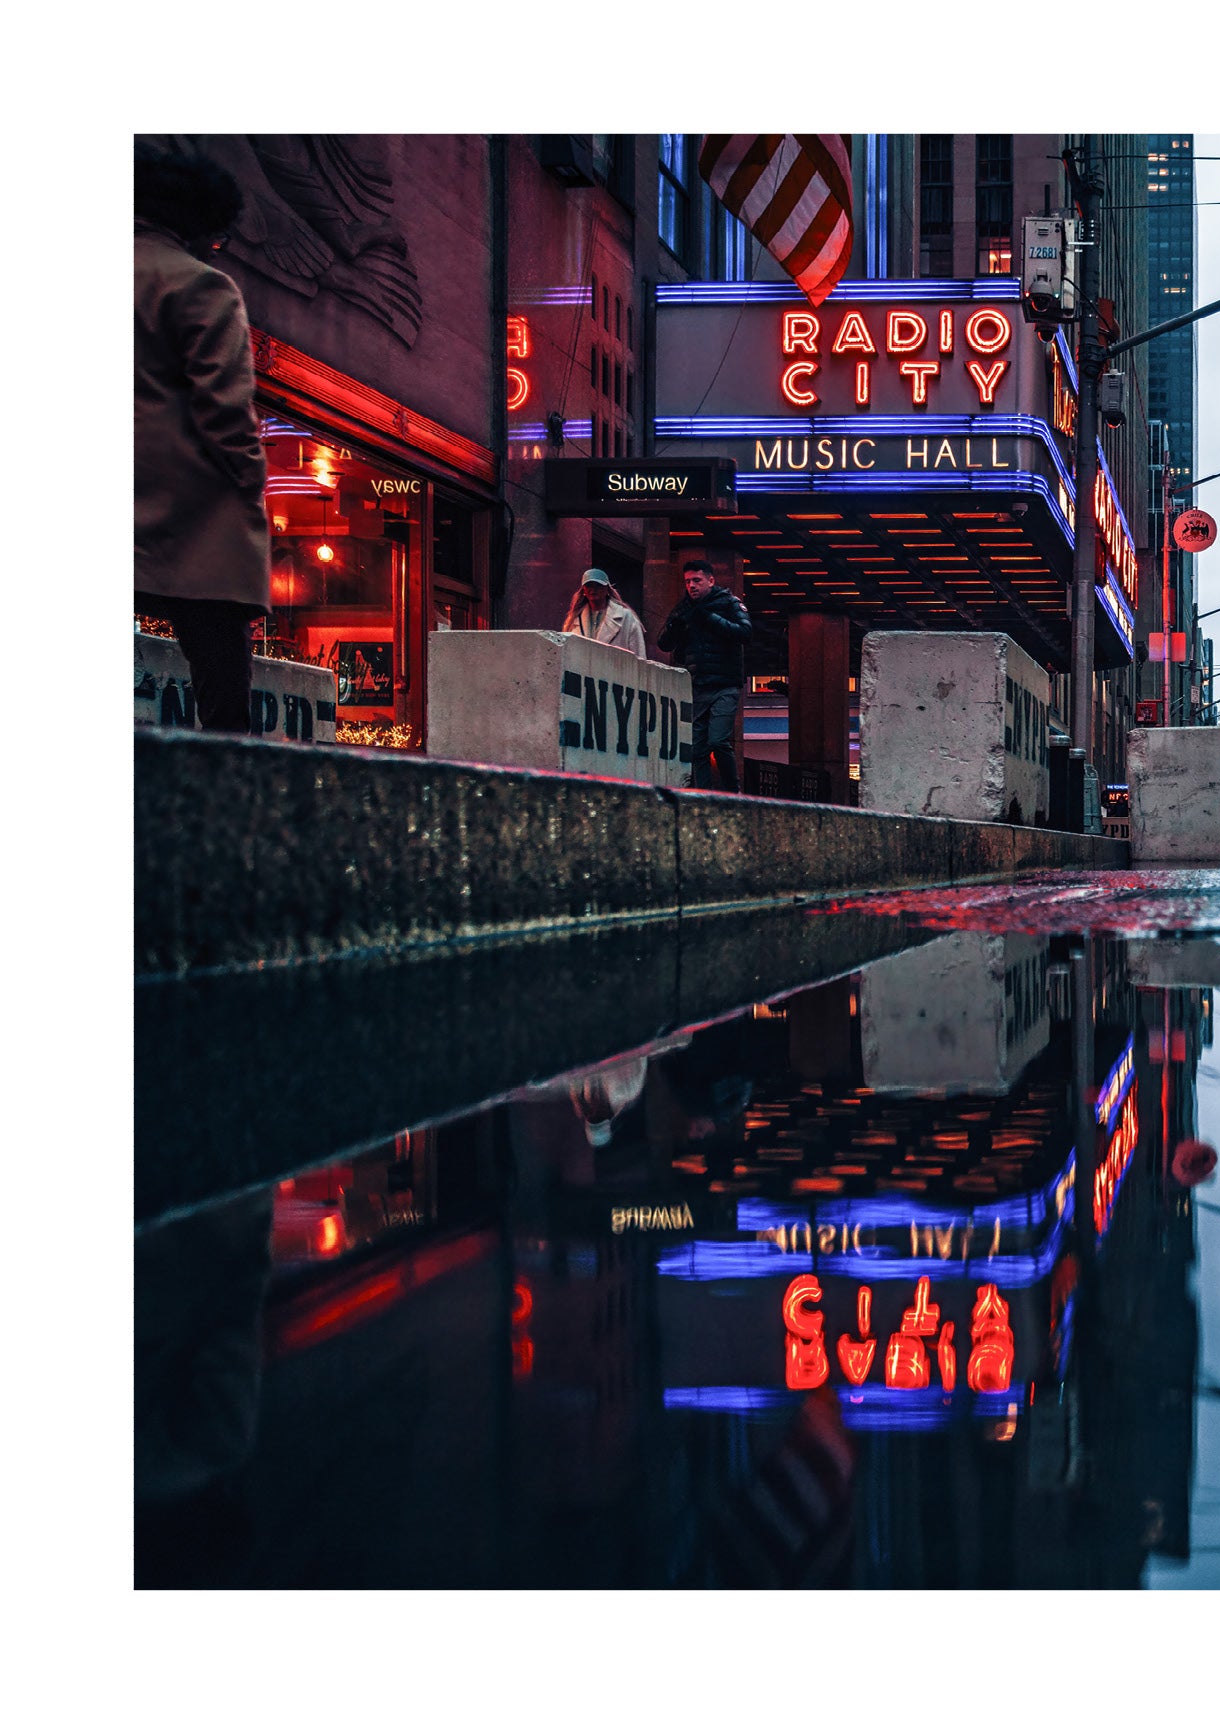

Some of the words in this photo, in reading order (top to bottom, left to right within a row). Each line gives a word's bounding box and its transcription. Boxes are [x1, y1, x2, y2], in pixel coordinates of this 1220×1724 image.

[783, 308, 1012, 354] RADIO
[781, 360, 1010, 405] CITY
[755, 438, 876, 470] MUSIC
[906, 438, 1010, 470] HALL
[607, 473, 688, 496] Subway
[161, 677, 313, 743] NPD
[583, 676, 678, 760] NYPD
